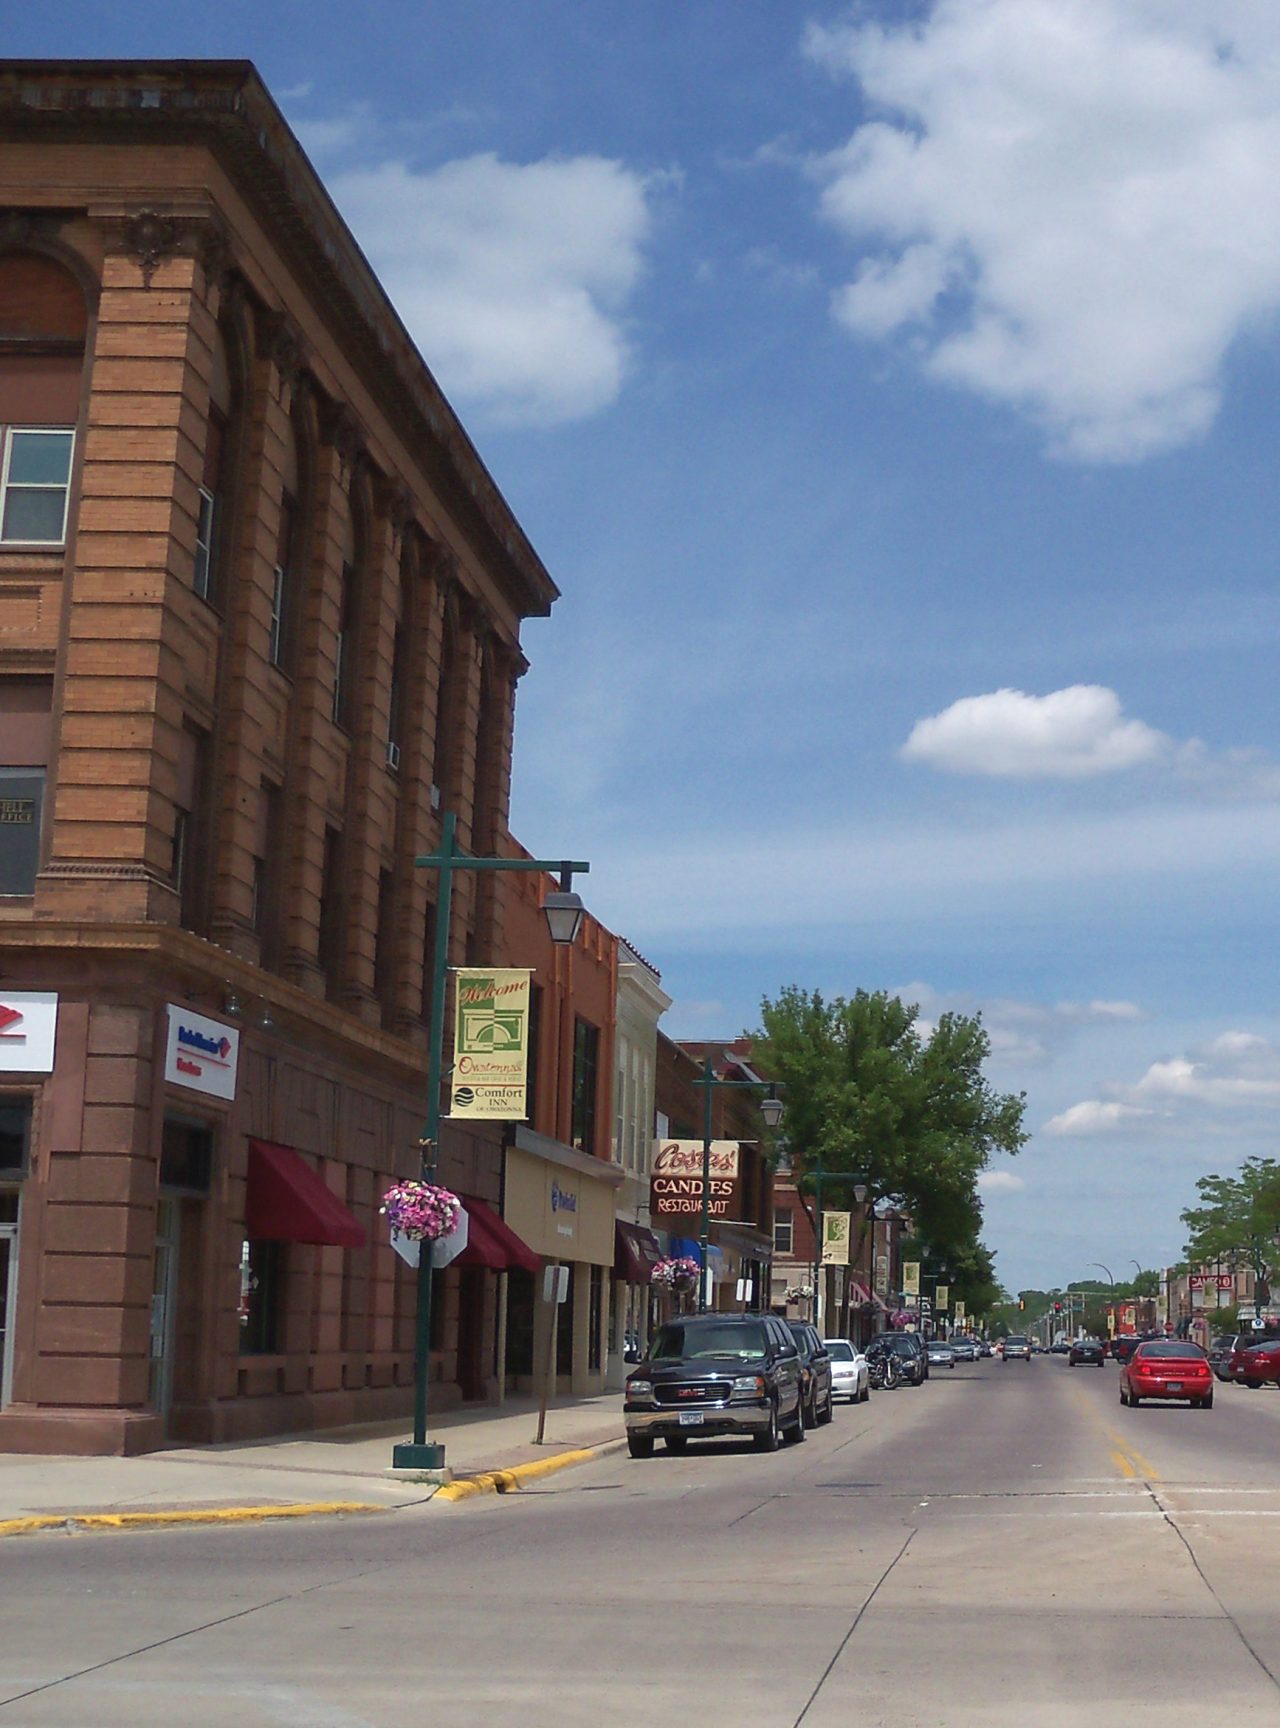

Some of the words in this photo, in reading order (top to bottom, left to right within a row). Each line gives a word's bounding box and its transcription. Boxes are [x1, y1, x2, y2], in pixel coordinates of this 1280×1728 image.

[459, 980, 528, 1005] Welcome
[475, 1087, 522, 1098] Comfort
[489, 1098, 508, 1106] INN
[653, 1179, 734, 1196] CANDES
